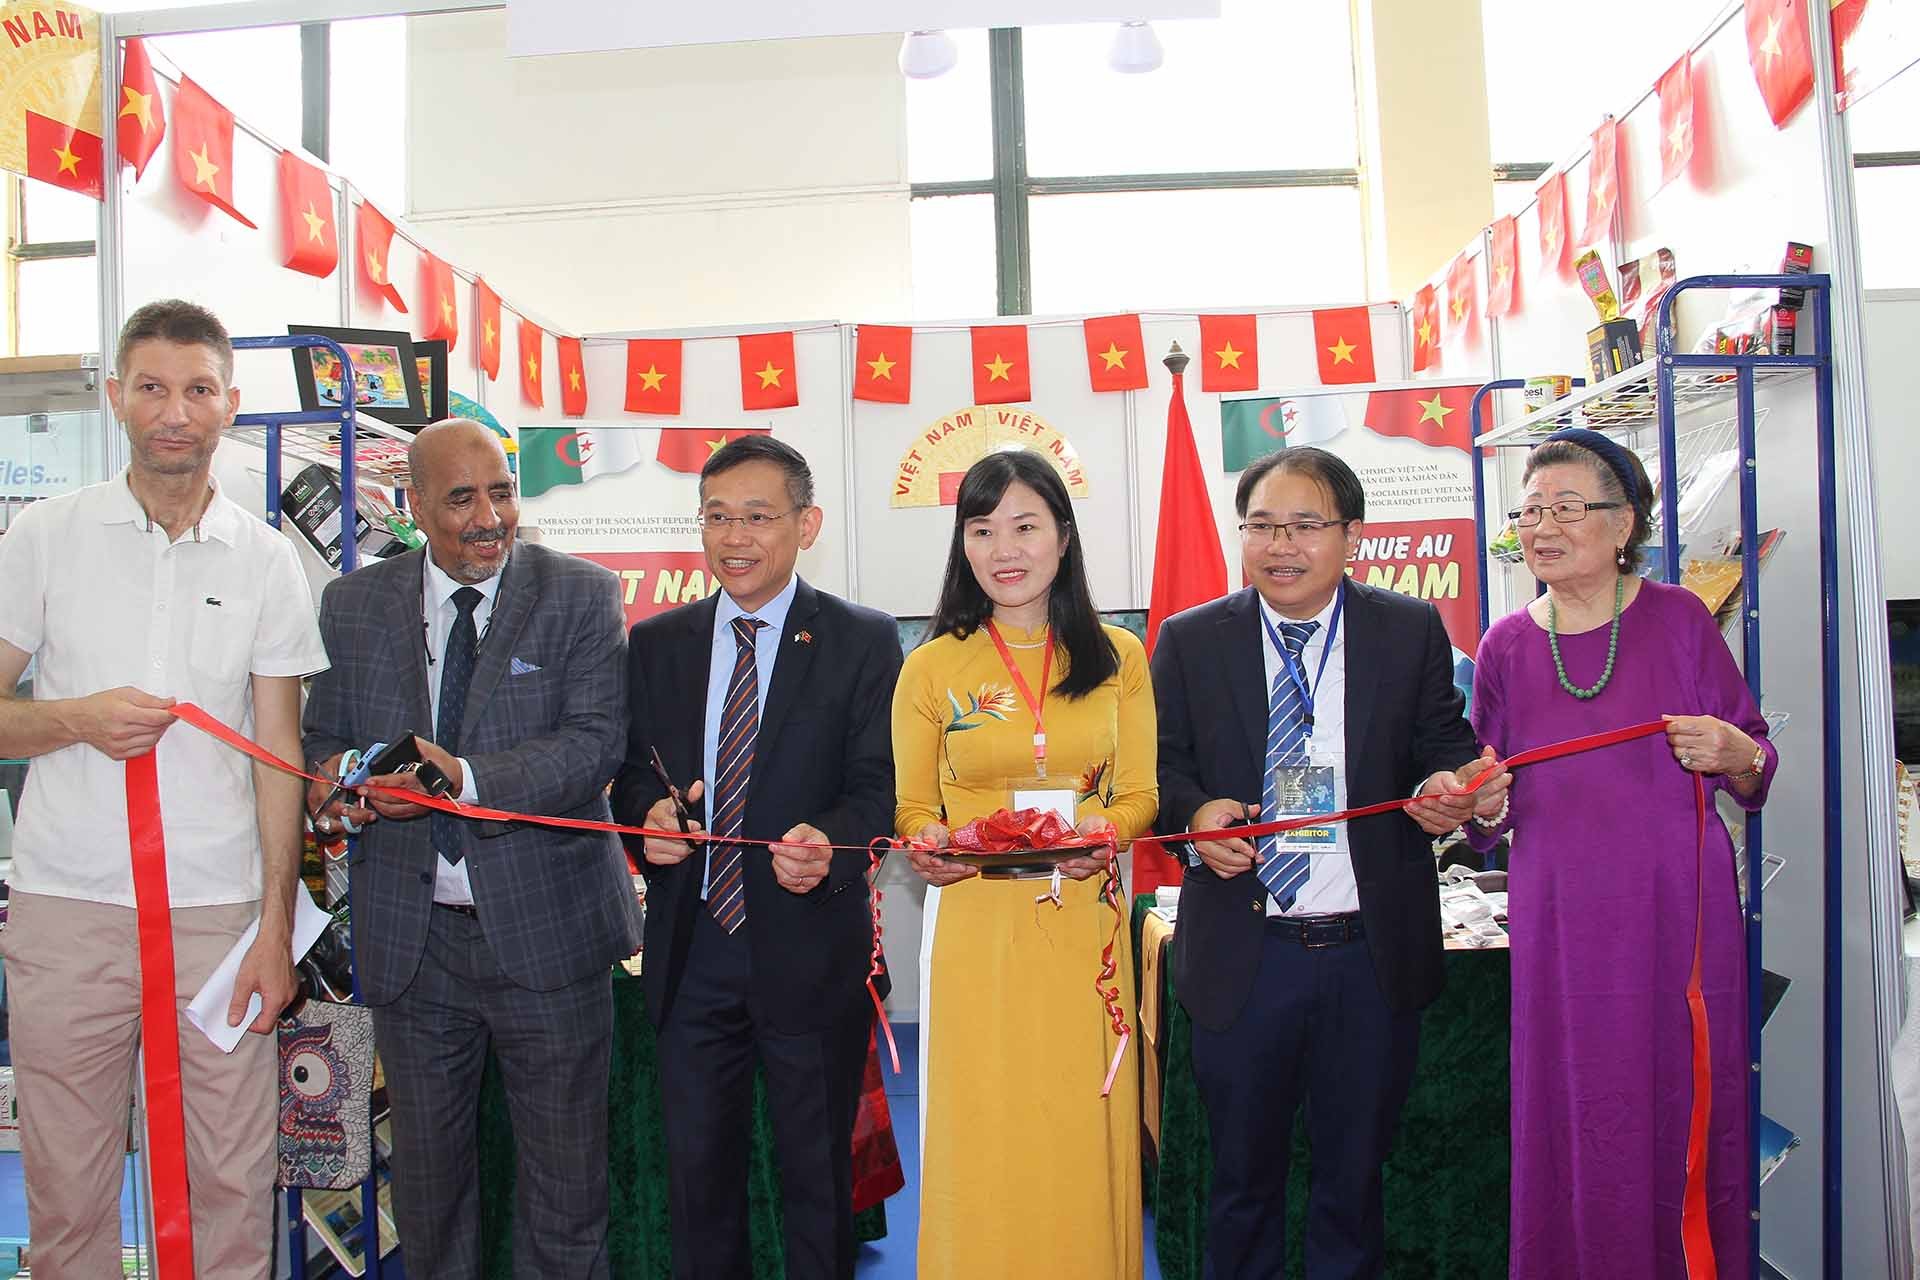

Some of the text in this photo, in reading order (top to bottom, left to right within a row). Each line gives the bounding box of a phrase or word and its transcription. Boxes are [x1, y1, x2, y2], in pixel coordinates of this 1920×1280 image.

[2, 10, 83, 48] NAM
[896, 413, 973, 495] VIỆT NAM
[998, 412, 1083, 486] VIỆT NAM
[1418, 464, 1439, 472] NAM
[1368, 498, 1422, 507] MOCRATIQUE
[1371, 488, 1419, 497] SOCIALISTE
[1421, 487, 1432, 495] DU
[538, 516, 698, 526] EMBASSY OF THE SOCIALIST REPUBLI
[549, 528, 565, 536] THE
[567, 527, 609, 536] PEOPLE'S
[609, 527, 669, 535] DEMOCRATIC
[1416, 533, 1453, 558] AU
[612, 570, 645, 604] T
[1366, 561, 1459, 600] NAM
